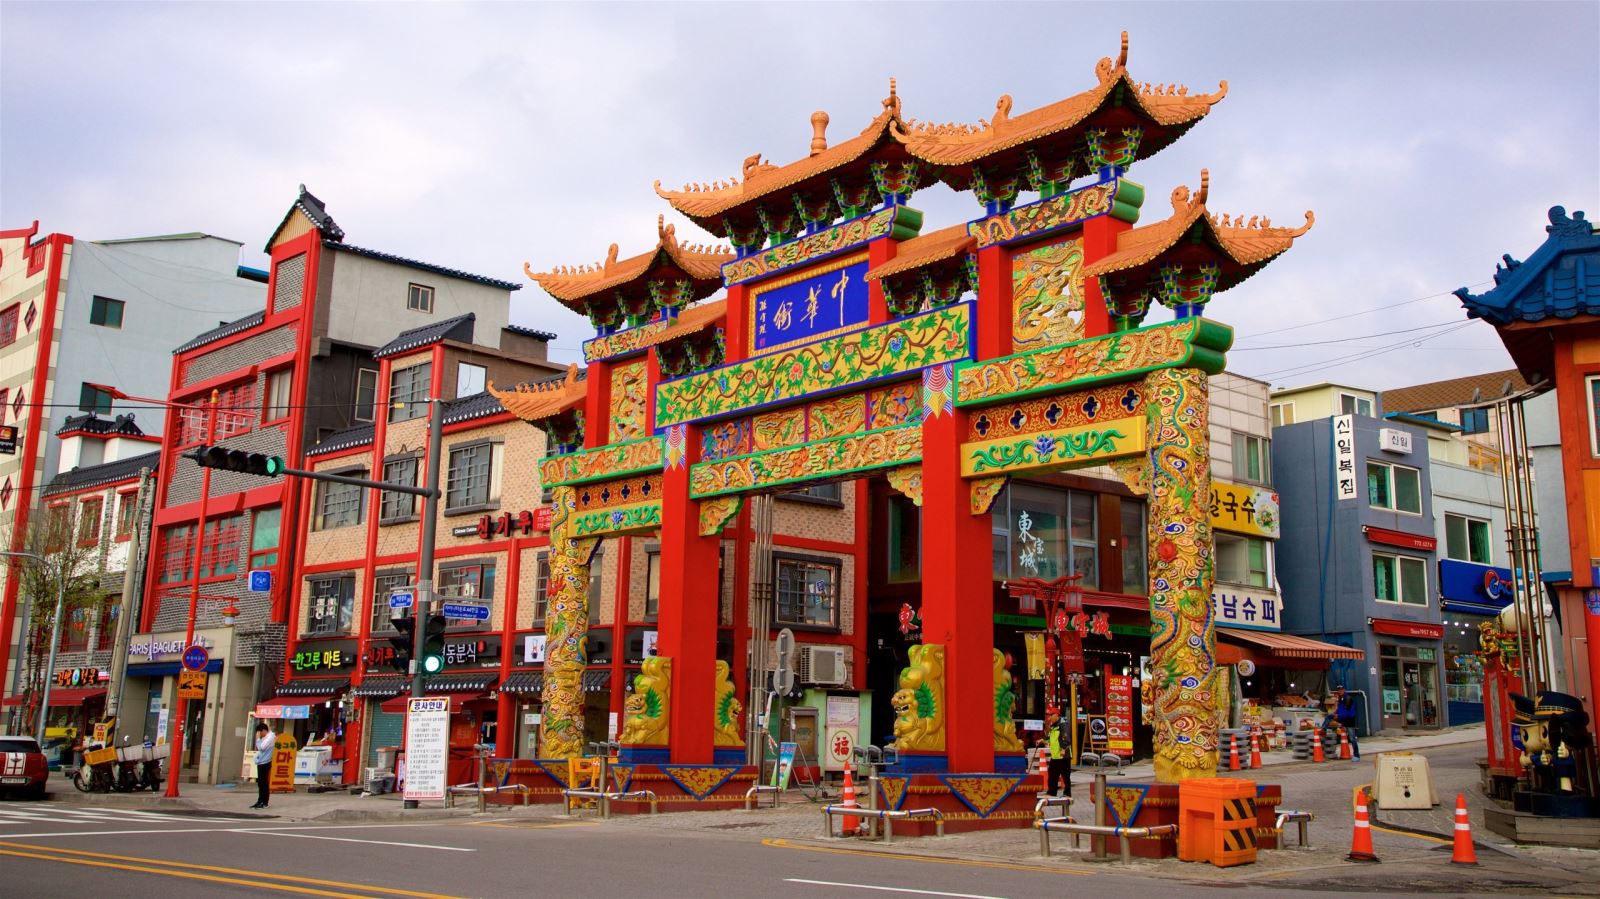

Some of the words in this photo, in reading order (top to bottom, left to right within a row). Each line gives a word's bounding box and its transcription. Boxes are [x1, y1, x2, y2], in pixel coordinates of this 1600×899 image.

[1337, 419, 1354, 495] 신일복집
[478, 511, 533, 539] 신기루
[296, 652, 321, 670] 한그루
[323, 650, 341, 669] 마트
[414, 702, 443, 710] 공사안내
[834, 736, 849, 756] 福
[275, 751, 293, 778] 마트
